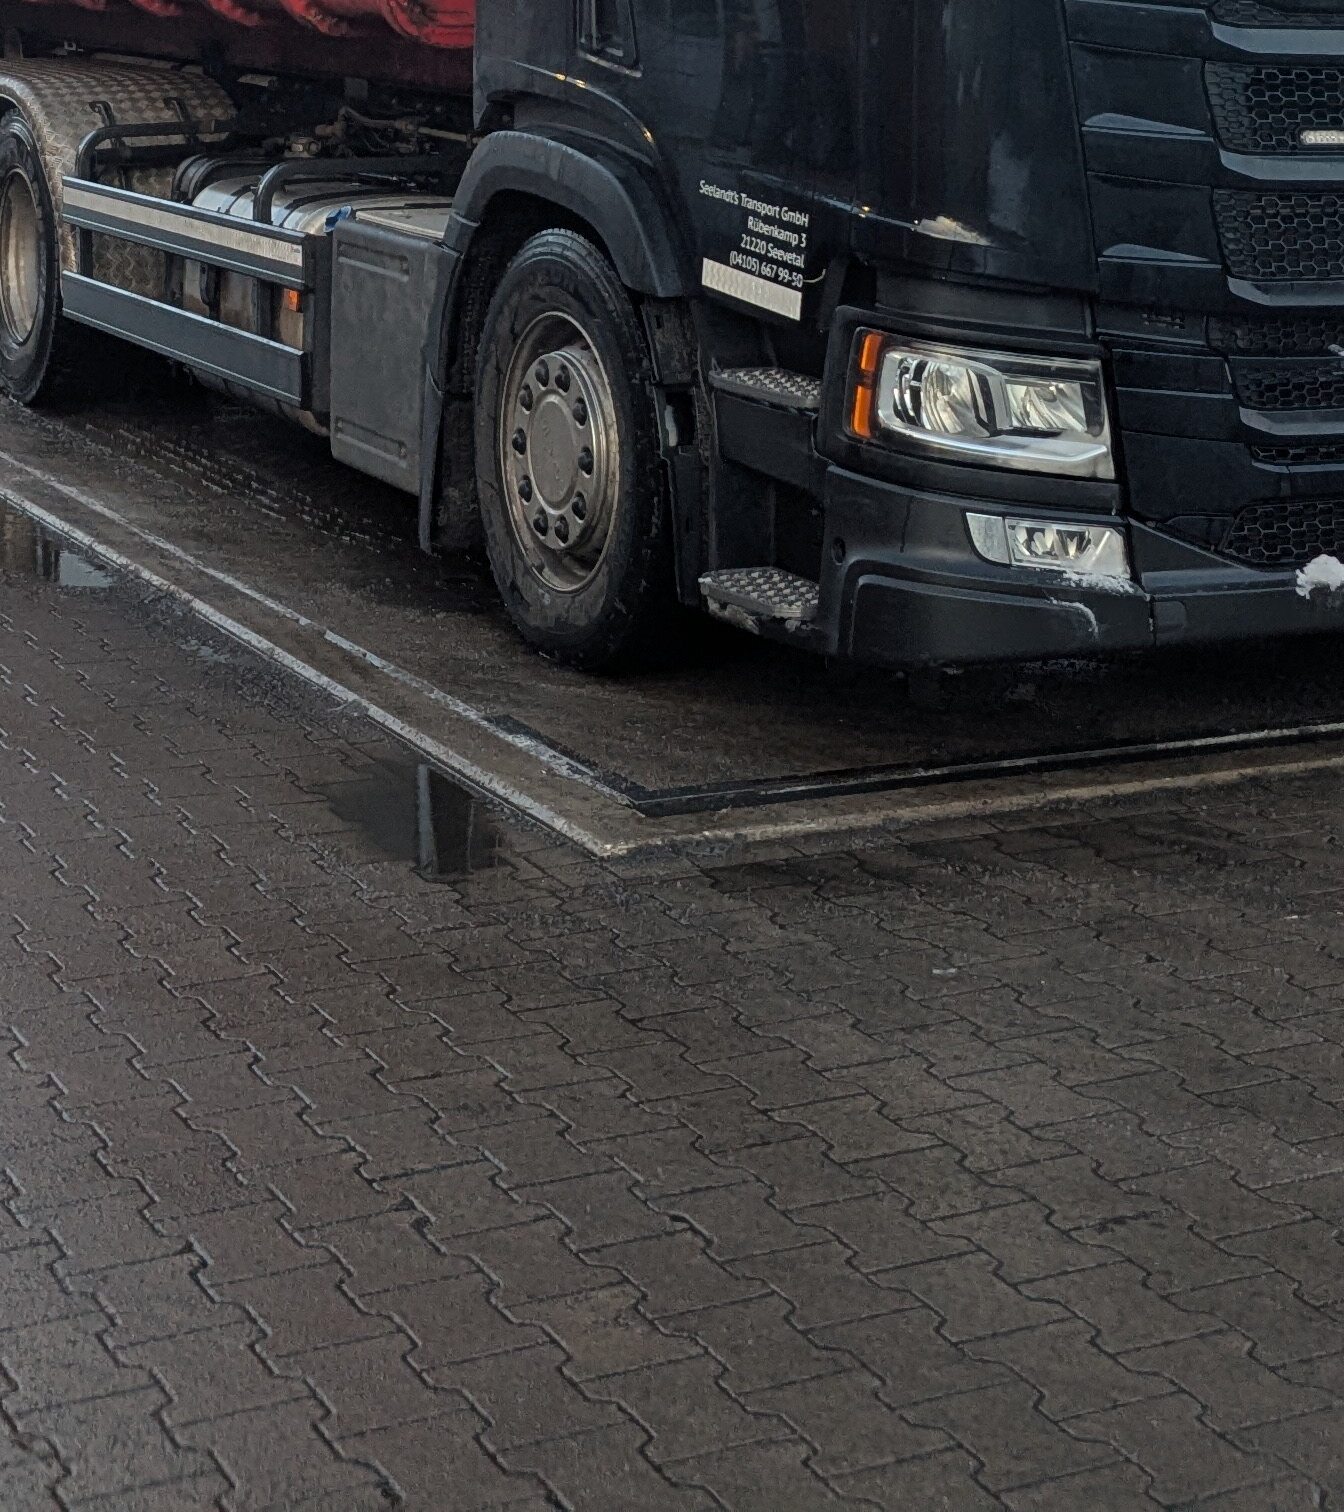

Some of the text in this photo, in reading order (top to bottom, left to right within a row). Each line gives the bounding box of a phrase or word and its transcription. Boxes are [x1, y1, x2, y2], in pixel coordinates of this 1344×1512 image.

[740, 192, 780, 219] Transport
[781, 206, 809, 227] GmbH
[741, 233, 805, 268] 21220 Seevetal
[801, 233, 807, 248] 3
[729, 251, 803, 288] (04105) 667 99-50
